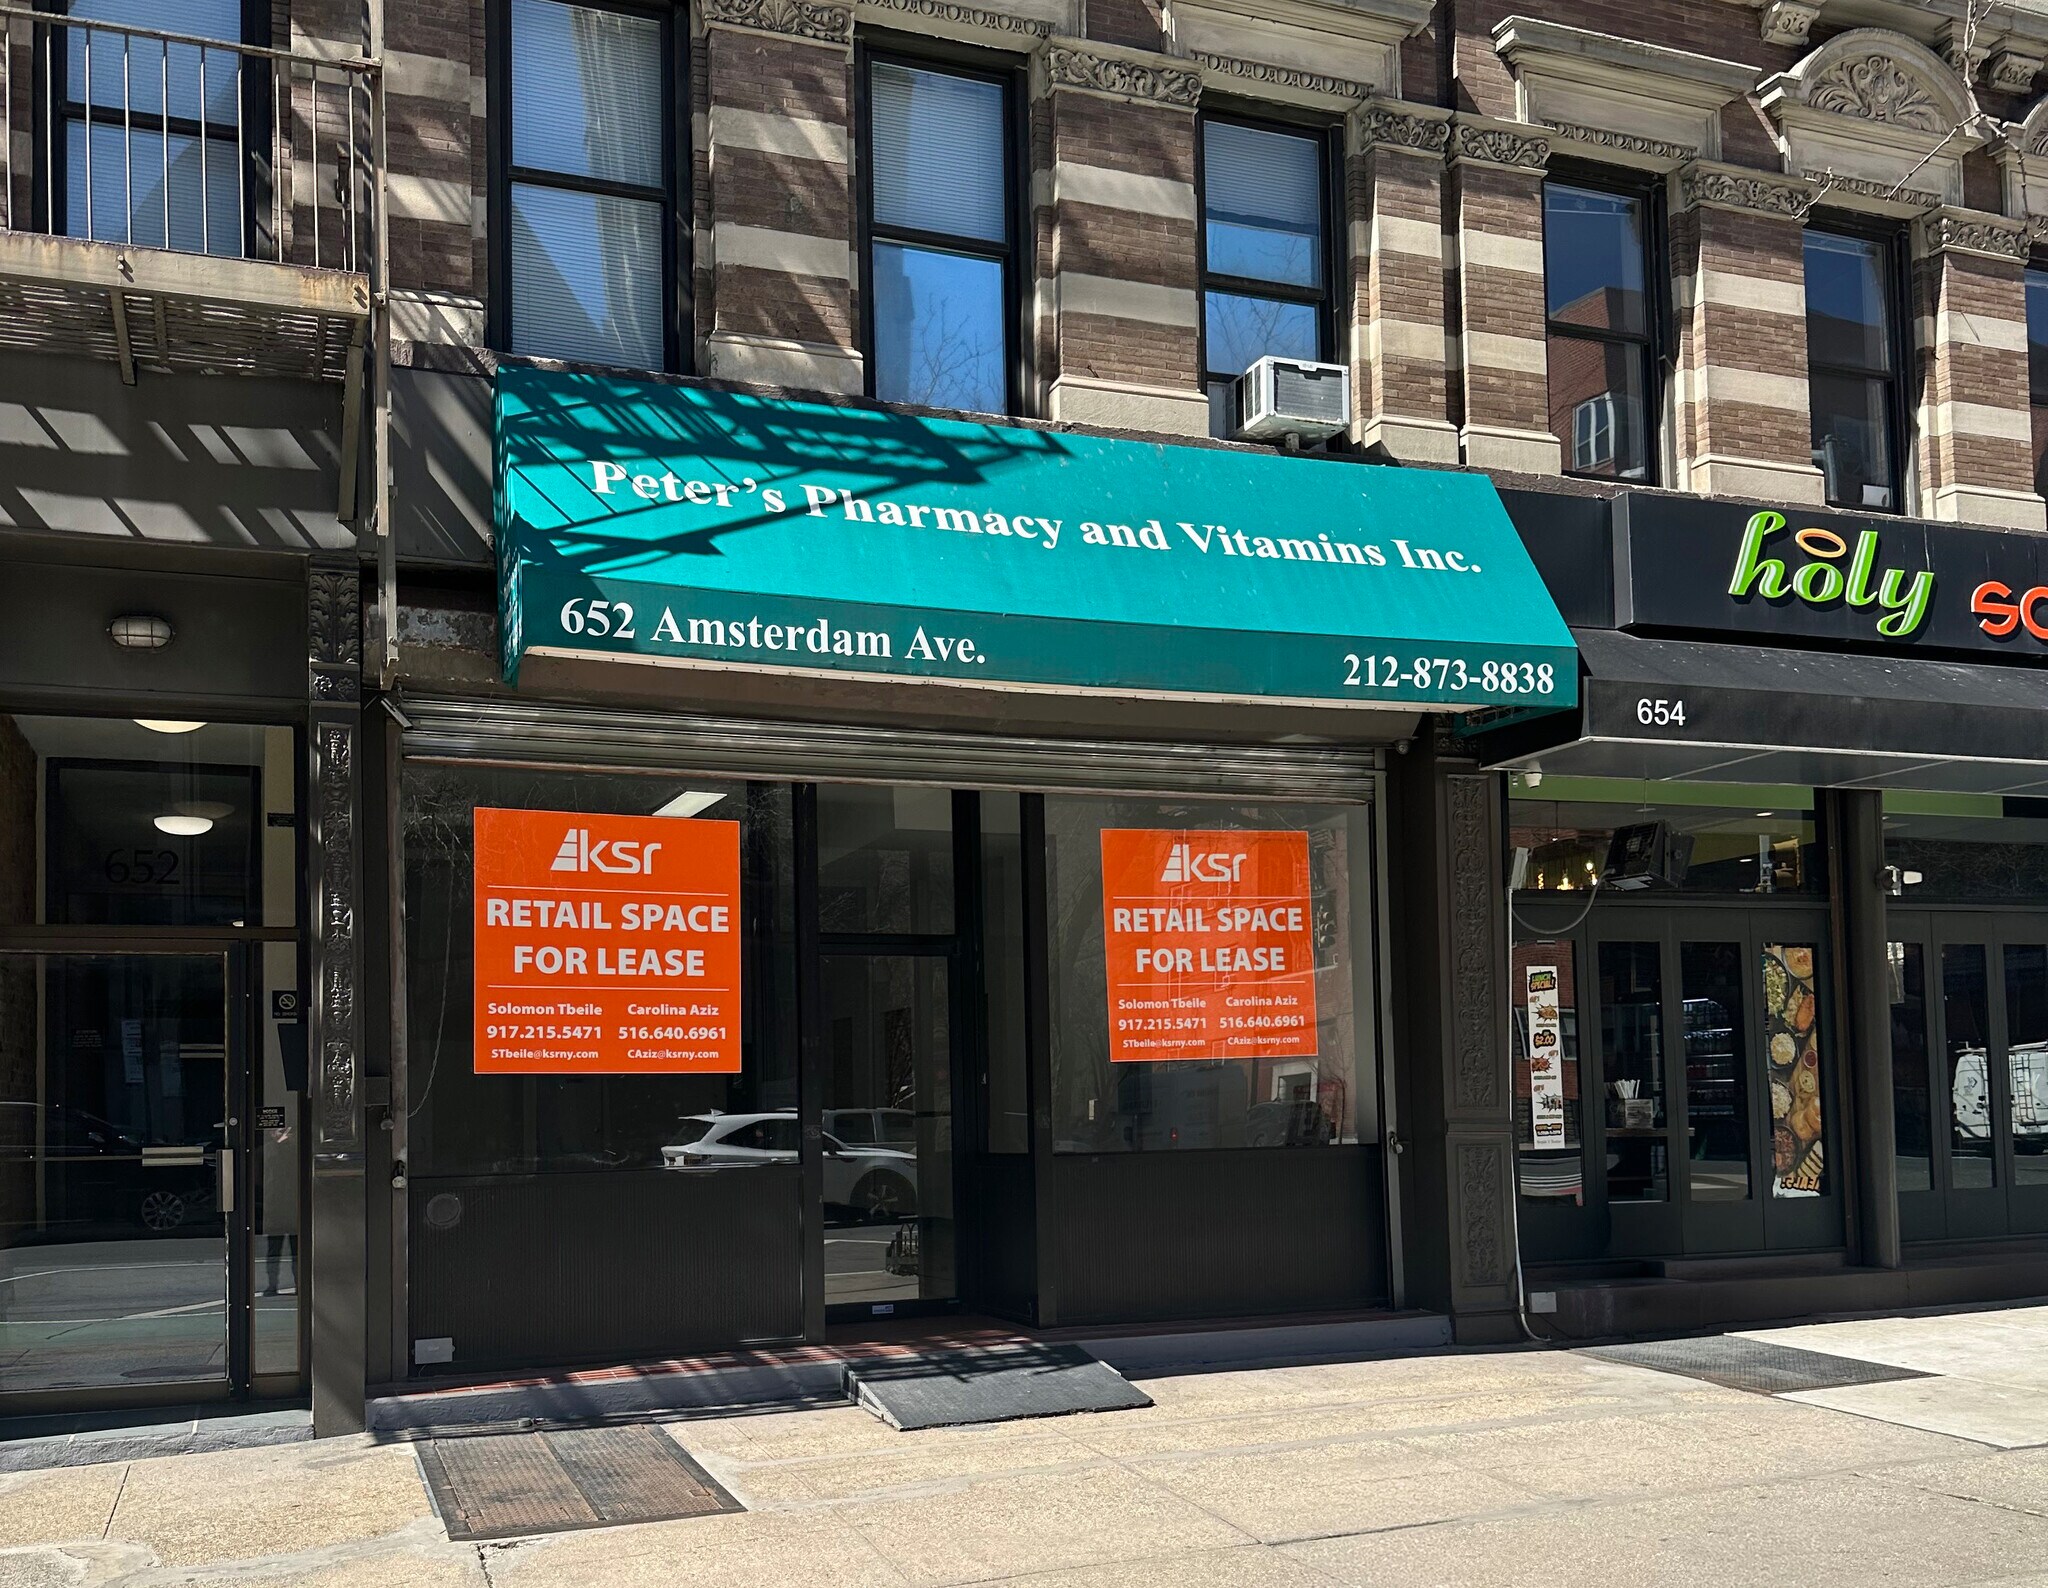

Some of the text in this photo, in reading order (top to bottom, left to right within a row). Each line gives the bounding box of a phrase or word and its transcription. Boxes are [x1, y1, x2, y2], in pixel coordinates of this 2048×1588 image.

[587, 458, 1483, 574] Peter's Pharmacy and Vitamins Inc.
[1728, 510, 1935, 637] holy
[560, 597, 987, 664] 652 Amsterdam Ave.
[1343, 654, 1555, 694] 212-873-8838
[1636, 698, 1686, 727] 654
[105, 848, 180, 885] 652
[488, 899, 728, 932] RETAIL SPACE
[1114, 908, 1302, 932] RETAIL SPACE
[515, 946, 704, 976] FOR LEASE
[1137, 948, 1285, 972] FOR LEASE
[1117, 998, 1207, 1010] Solomon Tbeile
[1225, 995, 1298, 1007] Carolina Aziz
[488, 1002, 603, 1016] Solomon Tbeile
[627, 1003, 719, 1016] Carolina Aziz
[1118, 1018, 1207, 1030] 917.215.5471
[1219, 1015, 1305, 1029] 516.640.6961
[486, 1025, 601, 1039] 917.215.5471
[618, 1026, 726, 1040] 516.640.6961
[1122, 1038, 1206, 1049] STbeile@ksrny.com
[1227, 1035, 1300, 1047] CAziz@ksrny.com
[491, 1048, 600, 1060] STbeile@ksrny.com
[627, 1048, 720, 1060] CAziz@ksrny.com
